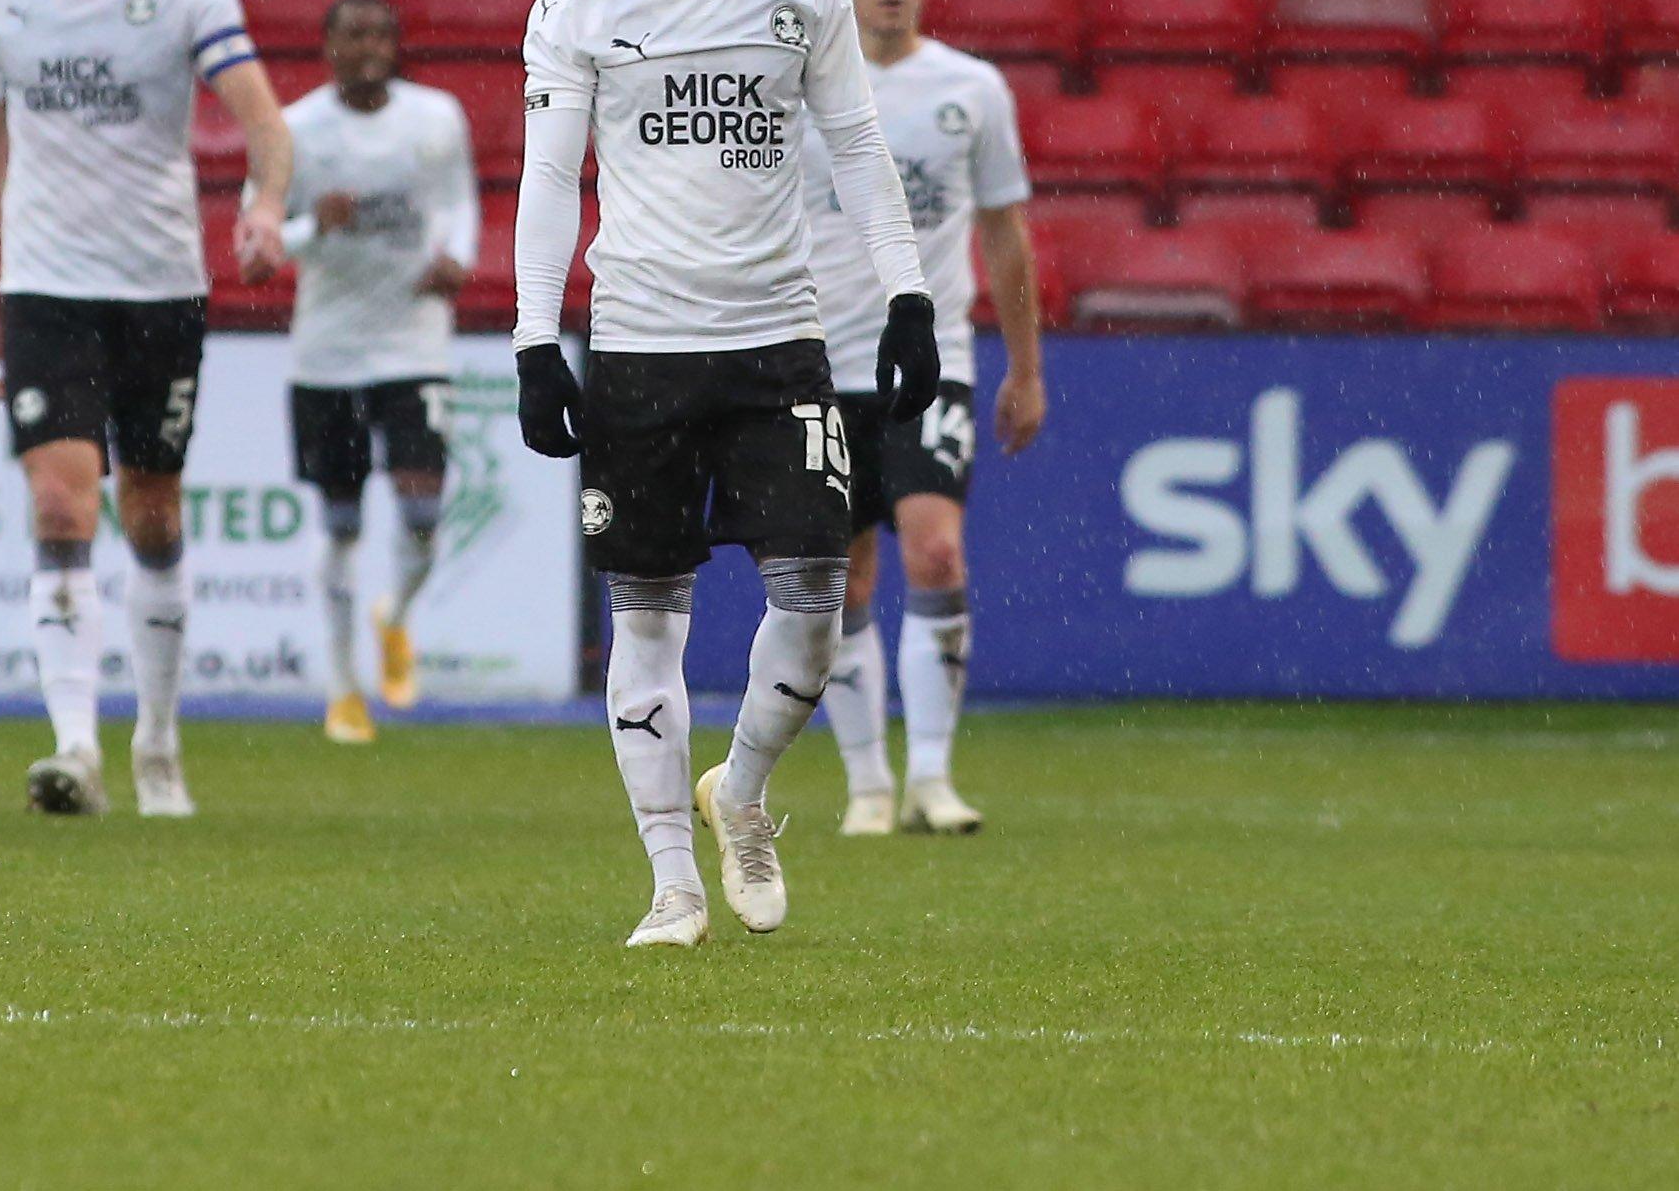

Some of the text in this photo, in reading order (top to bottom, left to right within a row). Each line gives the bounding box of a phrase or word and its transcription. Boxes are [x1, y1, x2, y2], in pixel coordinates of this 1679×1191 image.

[39, 56, 113, 82] MICK
[664, 73, 765, 108] MICK
[639, 111, 785, 146] GEORGE
[720, 148, 784, 170] GROUP
[161, 378, 196, 440] 5
[1124, 386, 1516, 650] sky
